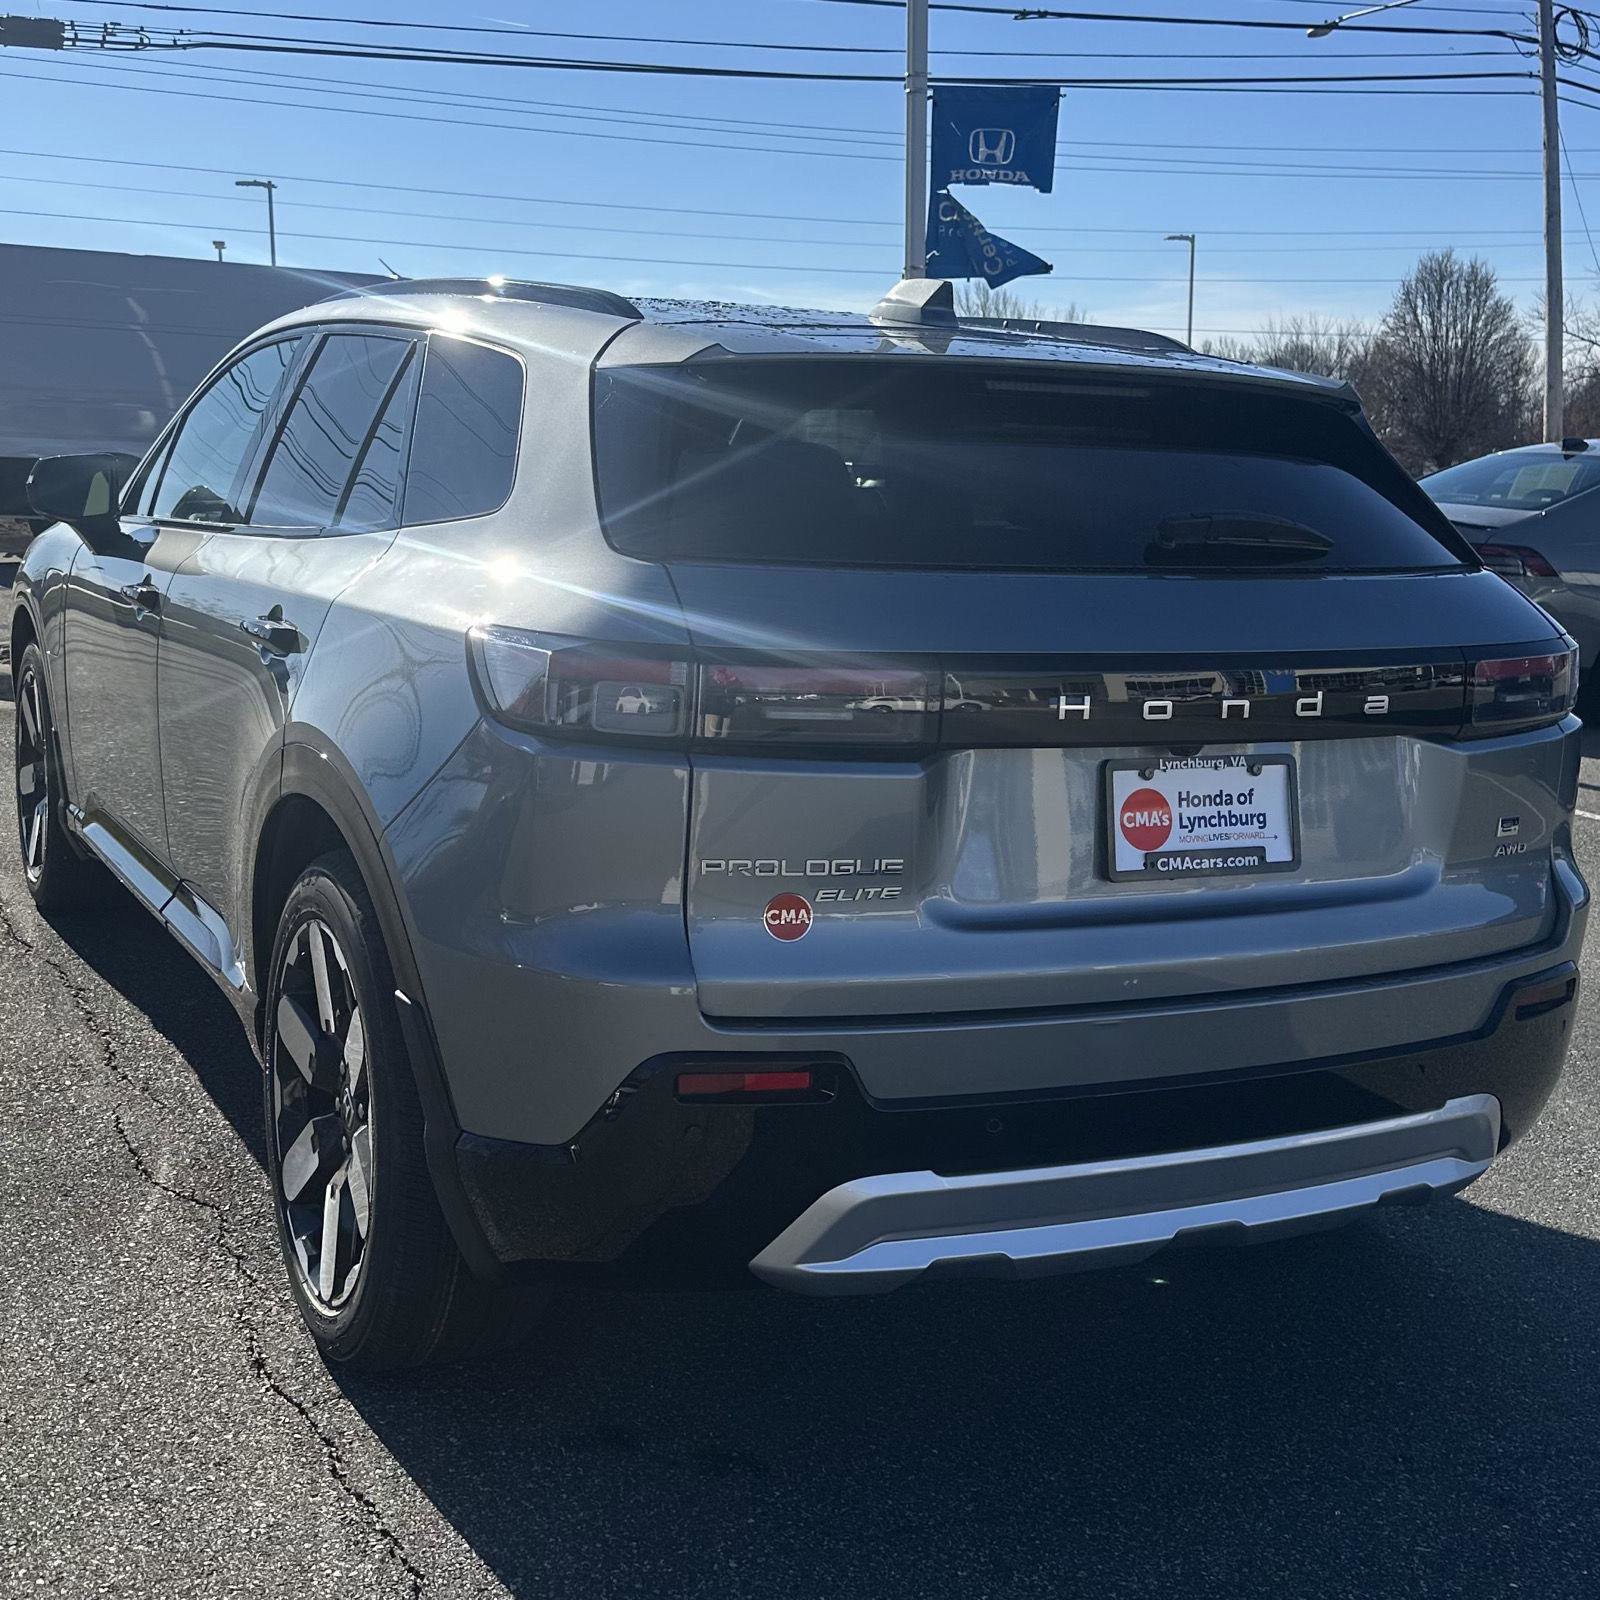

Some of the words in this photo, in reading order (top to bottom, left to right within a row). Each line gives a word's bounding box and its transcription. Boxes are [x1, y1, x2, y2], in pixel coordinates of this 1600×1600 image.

[950, 169, 1031, 182] HONDA
[1059, 691, 1390, 720] Honda
[1159, 757, 1228, 772] Lynchburg,
[1230, 756, 1247, 767] VA
[1178, 790, 1233, 808] Honda
[1236, 788, 1255, 805] of
[1123, 811, 1170, 828] CMA's
[1178, 810, 1267, 833] Lynchburg
[1494, 842, 1527, 858] AWD
[701, 858, 904, 877] PROLOGUE
[1156, 855, 1259, 872] CMAcars.com
[815, 886, 903, 903] ELITE
[766, 908, 810, 925] CMA
